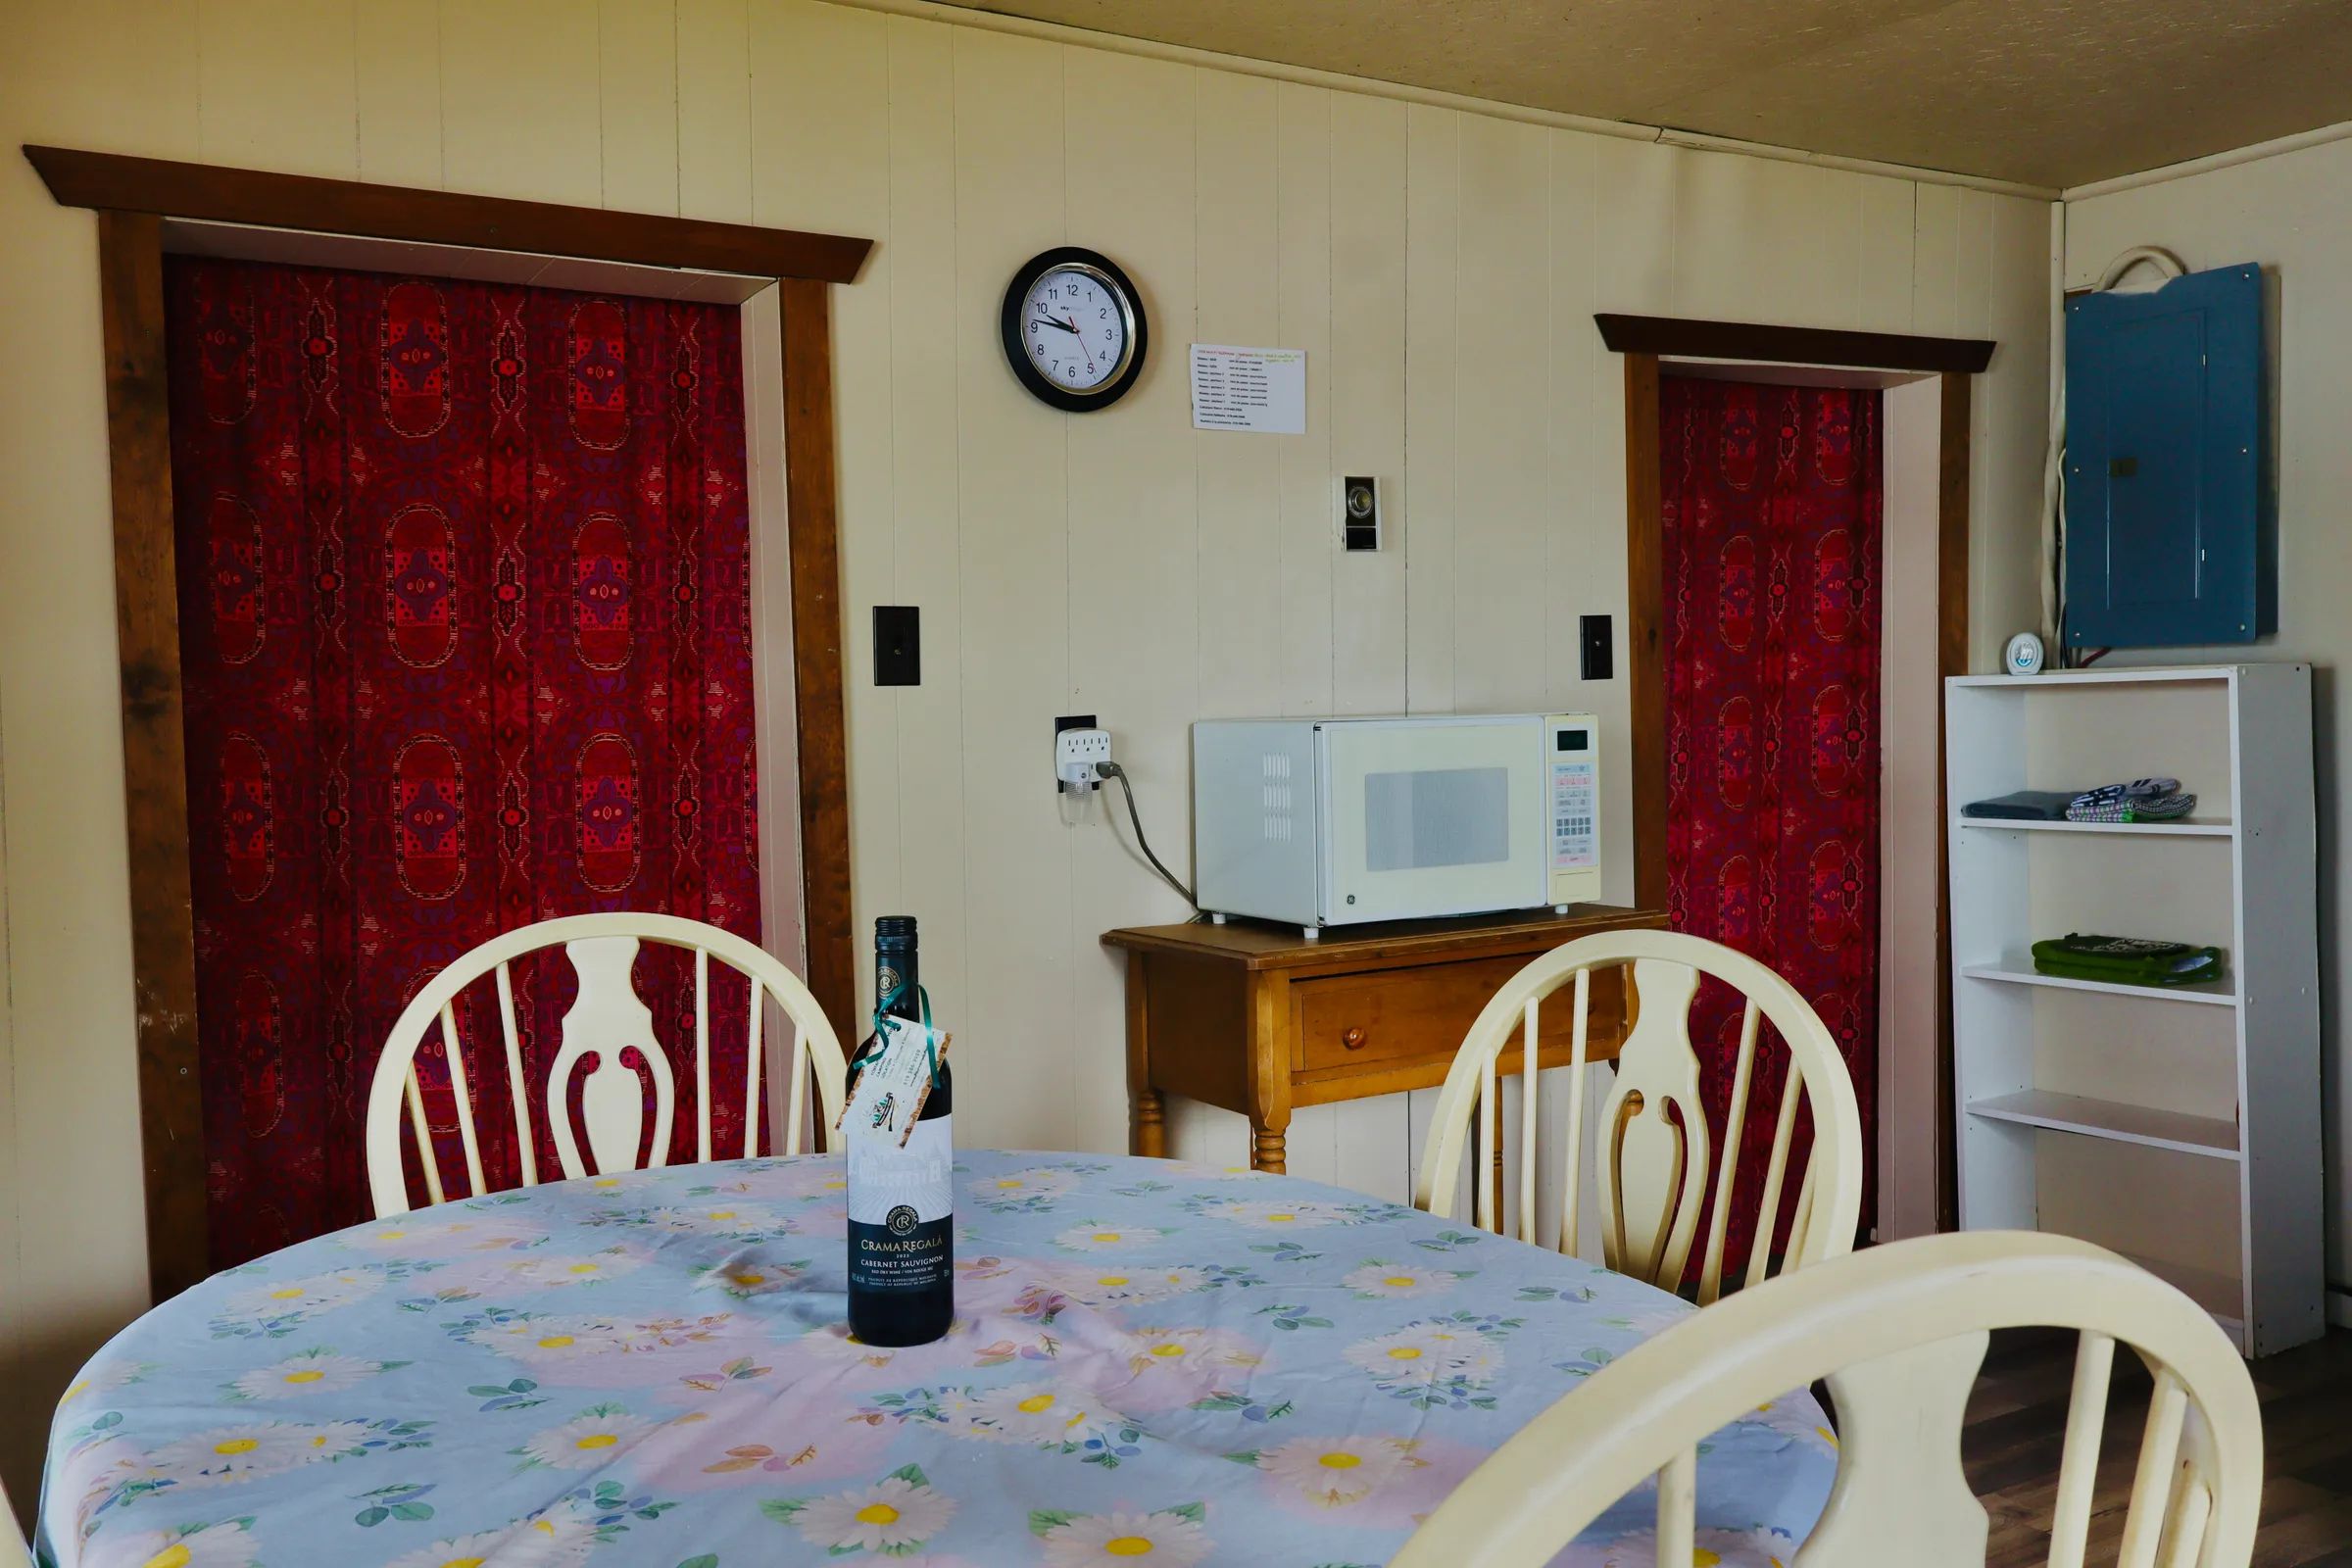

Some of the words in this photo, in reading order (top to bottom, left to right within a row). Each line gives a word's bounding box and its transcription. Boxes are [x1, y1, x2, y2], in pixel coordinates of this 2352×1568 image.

[1048, 288, 1058, 300] 11
[1066, 284, 1078, 296] 12
[1087, 292, 1093, 303] 1
[1037, 302, 1048, 315] 10
[1100, 308, 1106, 319] 2
[1031, 321, 1038, 333] 9
[1105, 329, 1112, 340] 3
[1037, 344, 1045, 356] 8
[1099, 351, 1106, 362] 4
[1052, 360, 1059, 370] 7
[1087, 363, 1094, 374] 5
[1068, 367, 1076, 378] 6
[860, 1239, 901, 1252] CRAMA
[860, 1259, 899, 1268] CABERNET
[901, 1254, 944, 1268] SAUVIGNON
